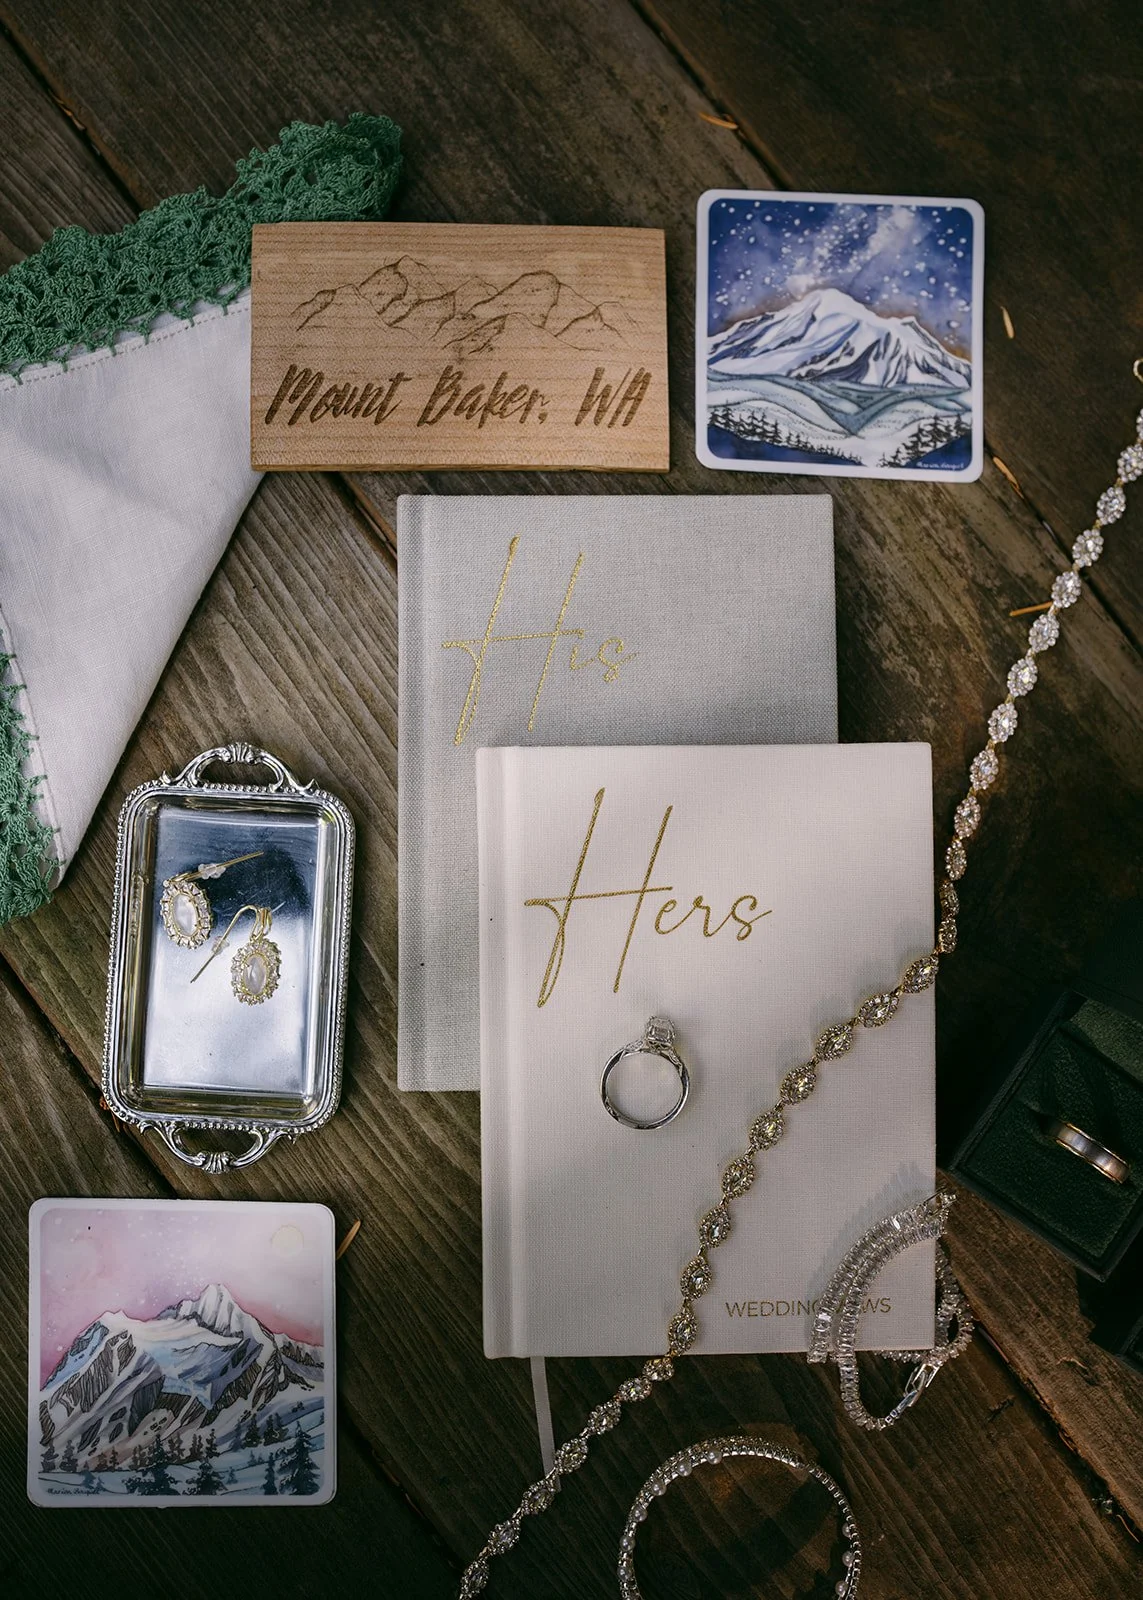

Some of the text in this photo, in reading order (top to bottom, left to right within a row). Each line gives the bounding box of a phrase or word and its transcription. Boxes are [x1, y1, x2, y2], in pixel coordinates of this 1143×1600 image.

[265, 363, 412, 426] Mount
[574, 366, 653, 429] WA
[441, 534, 640, 747] His
[523, 787, 773, 1009] Hers
